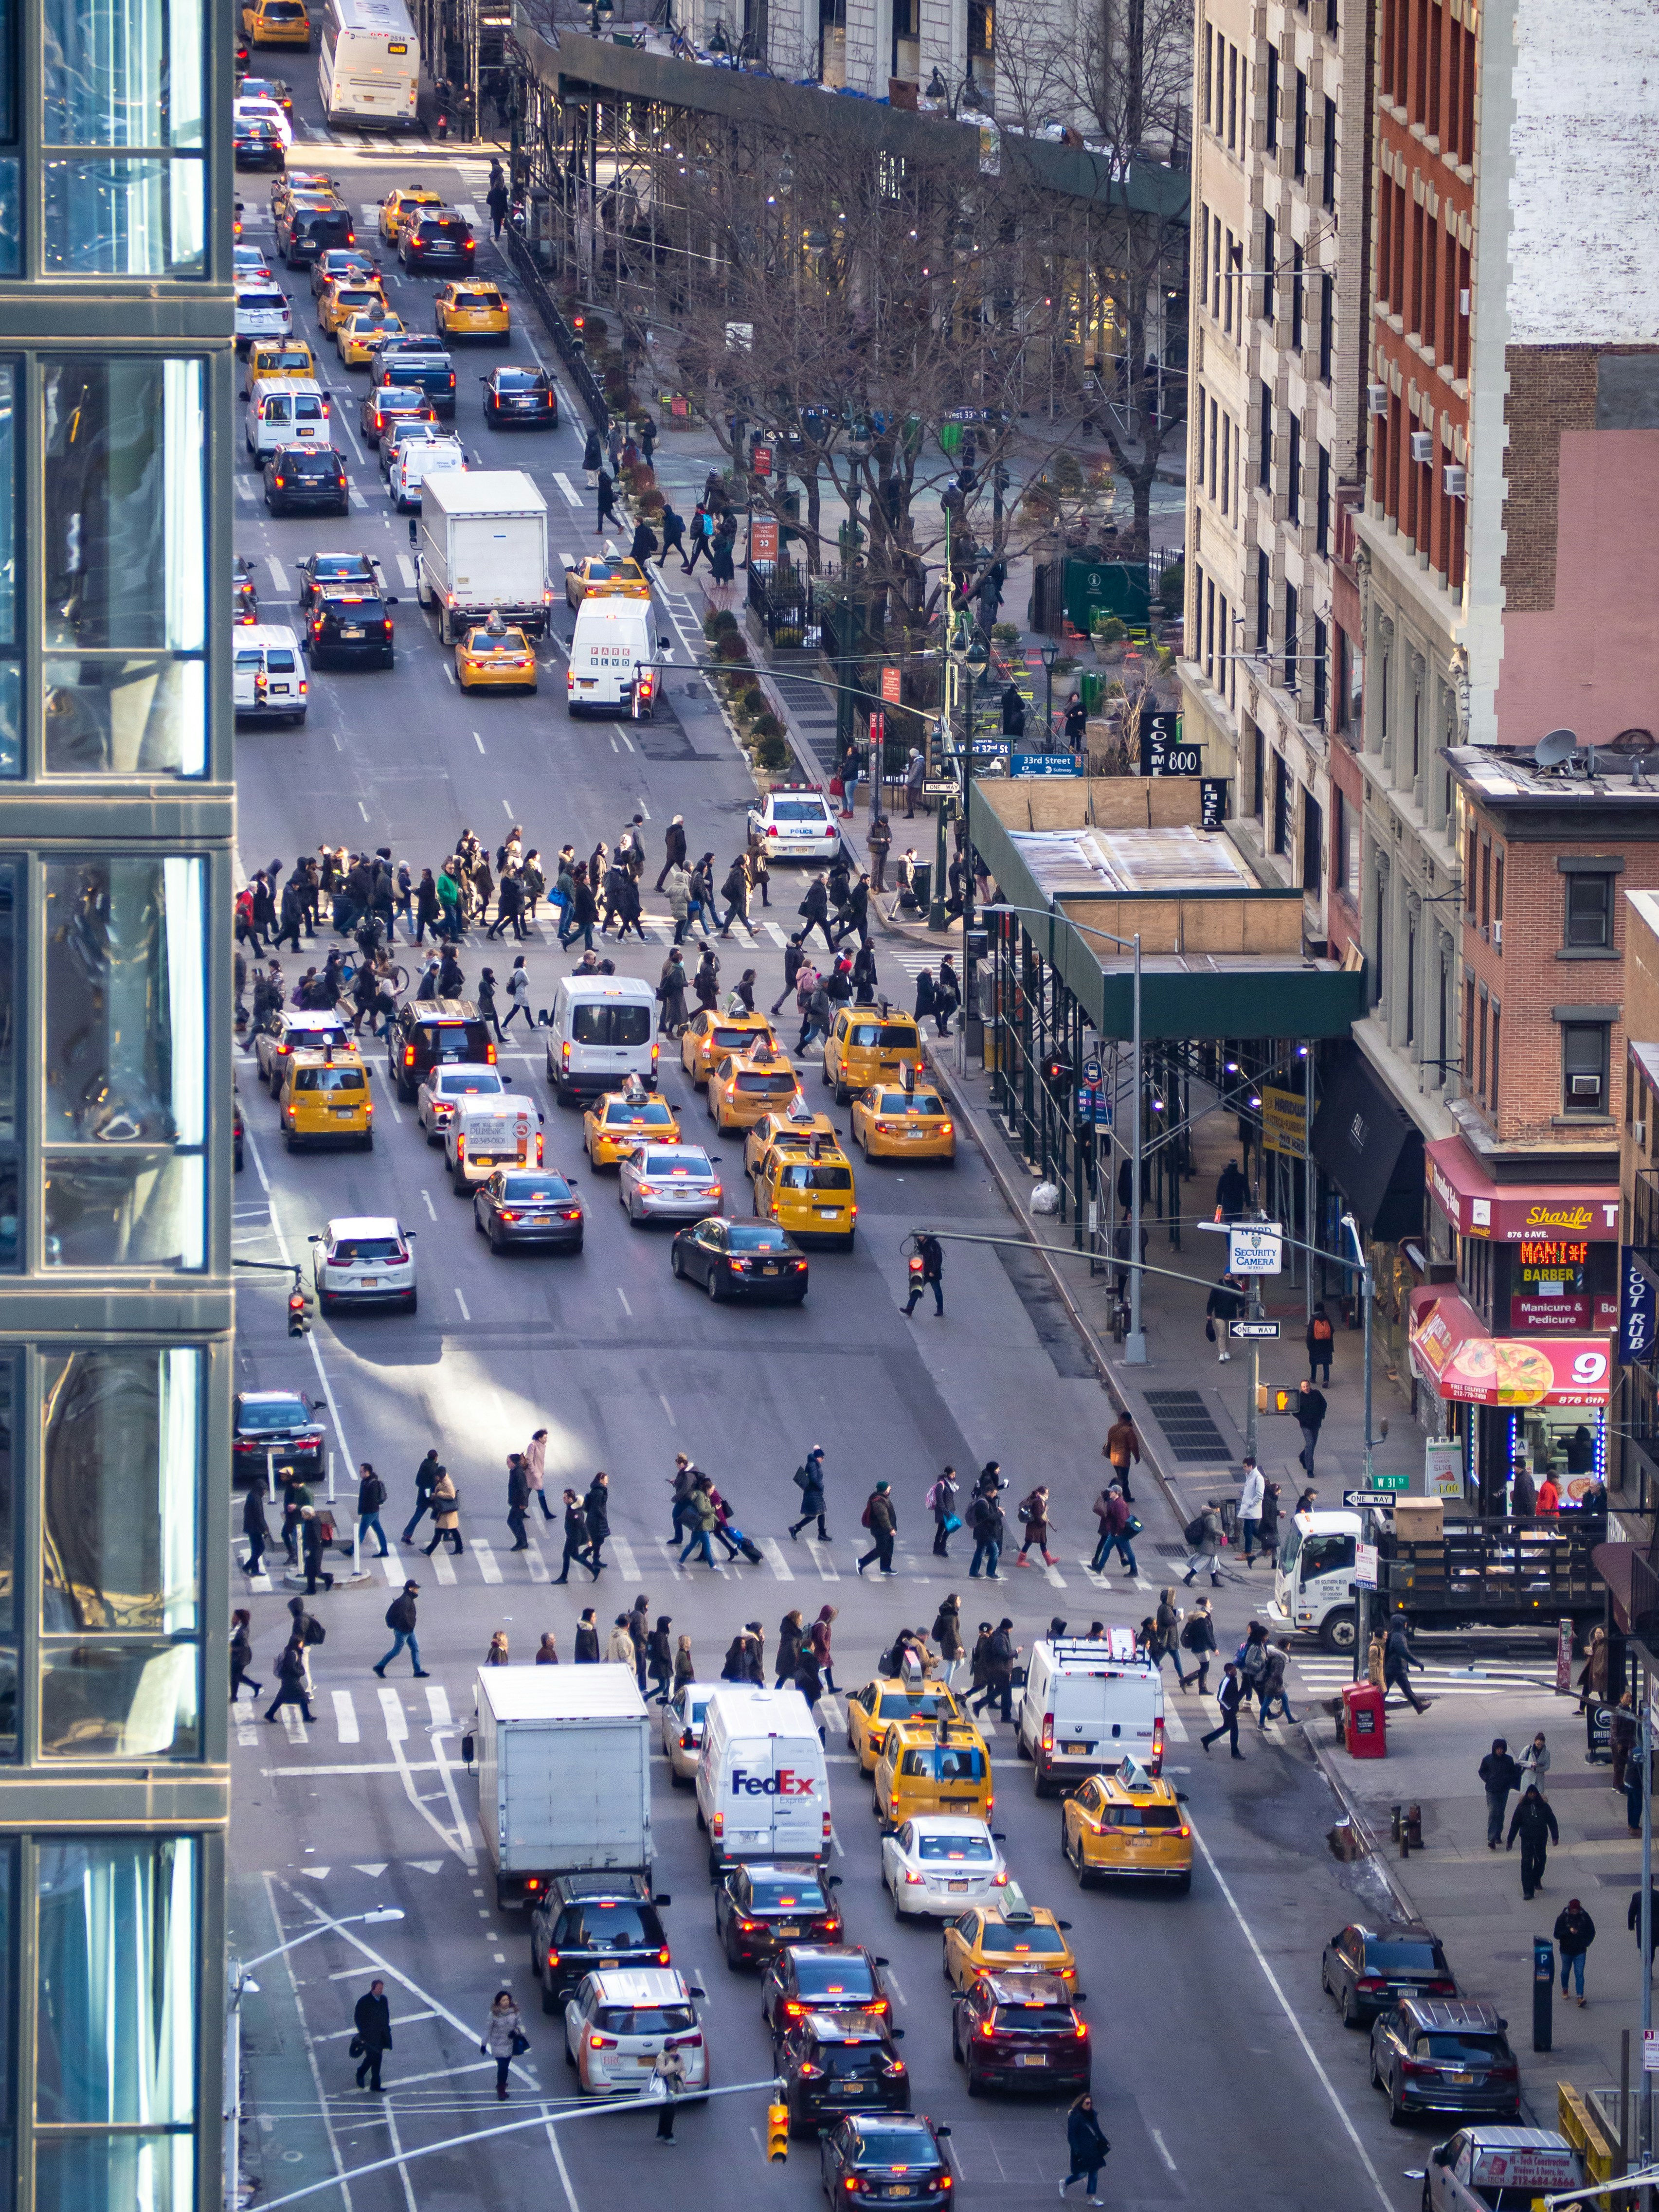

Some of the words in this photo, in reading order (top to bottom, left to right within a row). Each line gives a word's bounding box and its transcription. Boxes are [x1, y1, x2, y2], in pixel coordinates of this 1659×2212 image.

[981, 744, 997, 753] 32nd
[999, 745, 1008, 753] St
[1169, 752, 1196, 770] 800
[1203, 784, 1218, 825] LASER
[1275, 1097, 1306, 1118] HARDWA
[1526, 1206, 1593, 1228] Sharifa
[1235, 1247, 1277, 1256] SECURITY
[1236, 1257, 1275, 1265] CAMERA
[1523, 1268, 1574, 1281] BARBER
[1629, 1266, 1645, 1308] OOT
[1521, 1303, 1571, 1312] Manicure
[1574, 1303, 1583, 1312] &
[1528, 1315, 1576, 1324] Pedicure
[1628, 1313, 1645, 1349] RUB
[1464, 1385, 1488, 1394] DELIVERY
[1454, 1390, 1487, 1400] 212-779-7498
[1517, 1441, 1525, 1450] A
[1378, 1478, 1384, 1488] W
[1388, 1478, 1395, 1488] 31
[1593, 1730, 1612, 1739] GREGO
[732, 1769, 815, 1796] FedEx
[780, 1796, 811, 1806] Express
[1541, 1954, 1548, 1964] P
[1520, 2156, 1533, 2165] Tech
[1533, 2156, 1570, 2167] Construction
[1514, 2166, 1534, 2175] Windows
[1536, 2167, 1540, 2176] &
